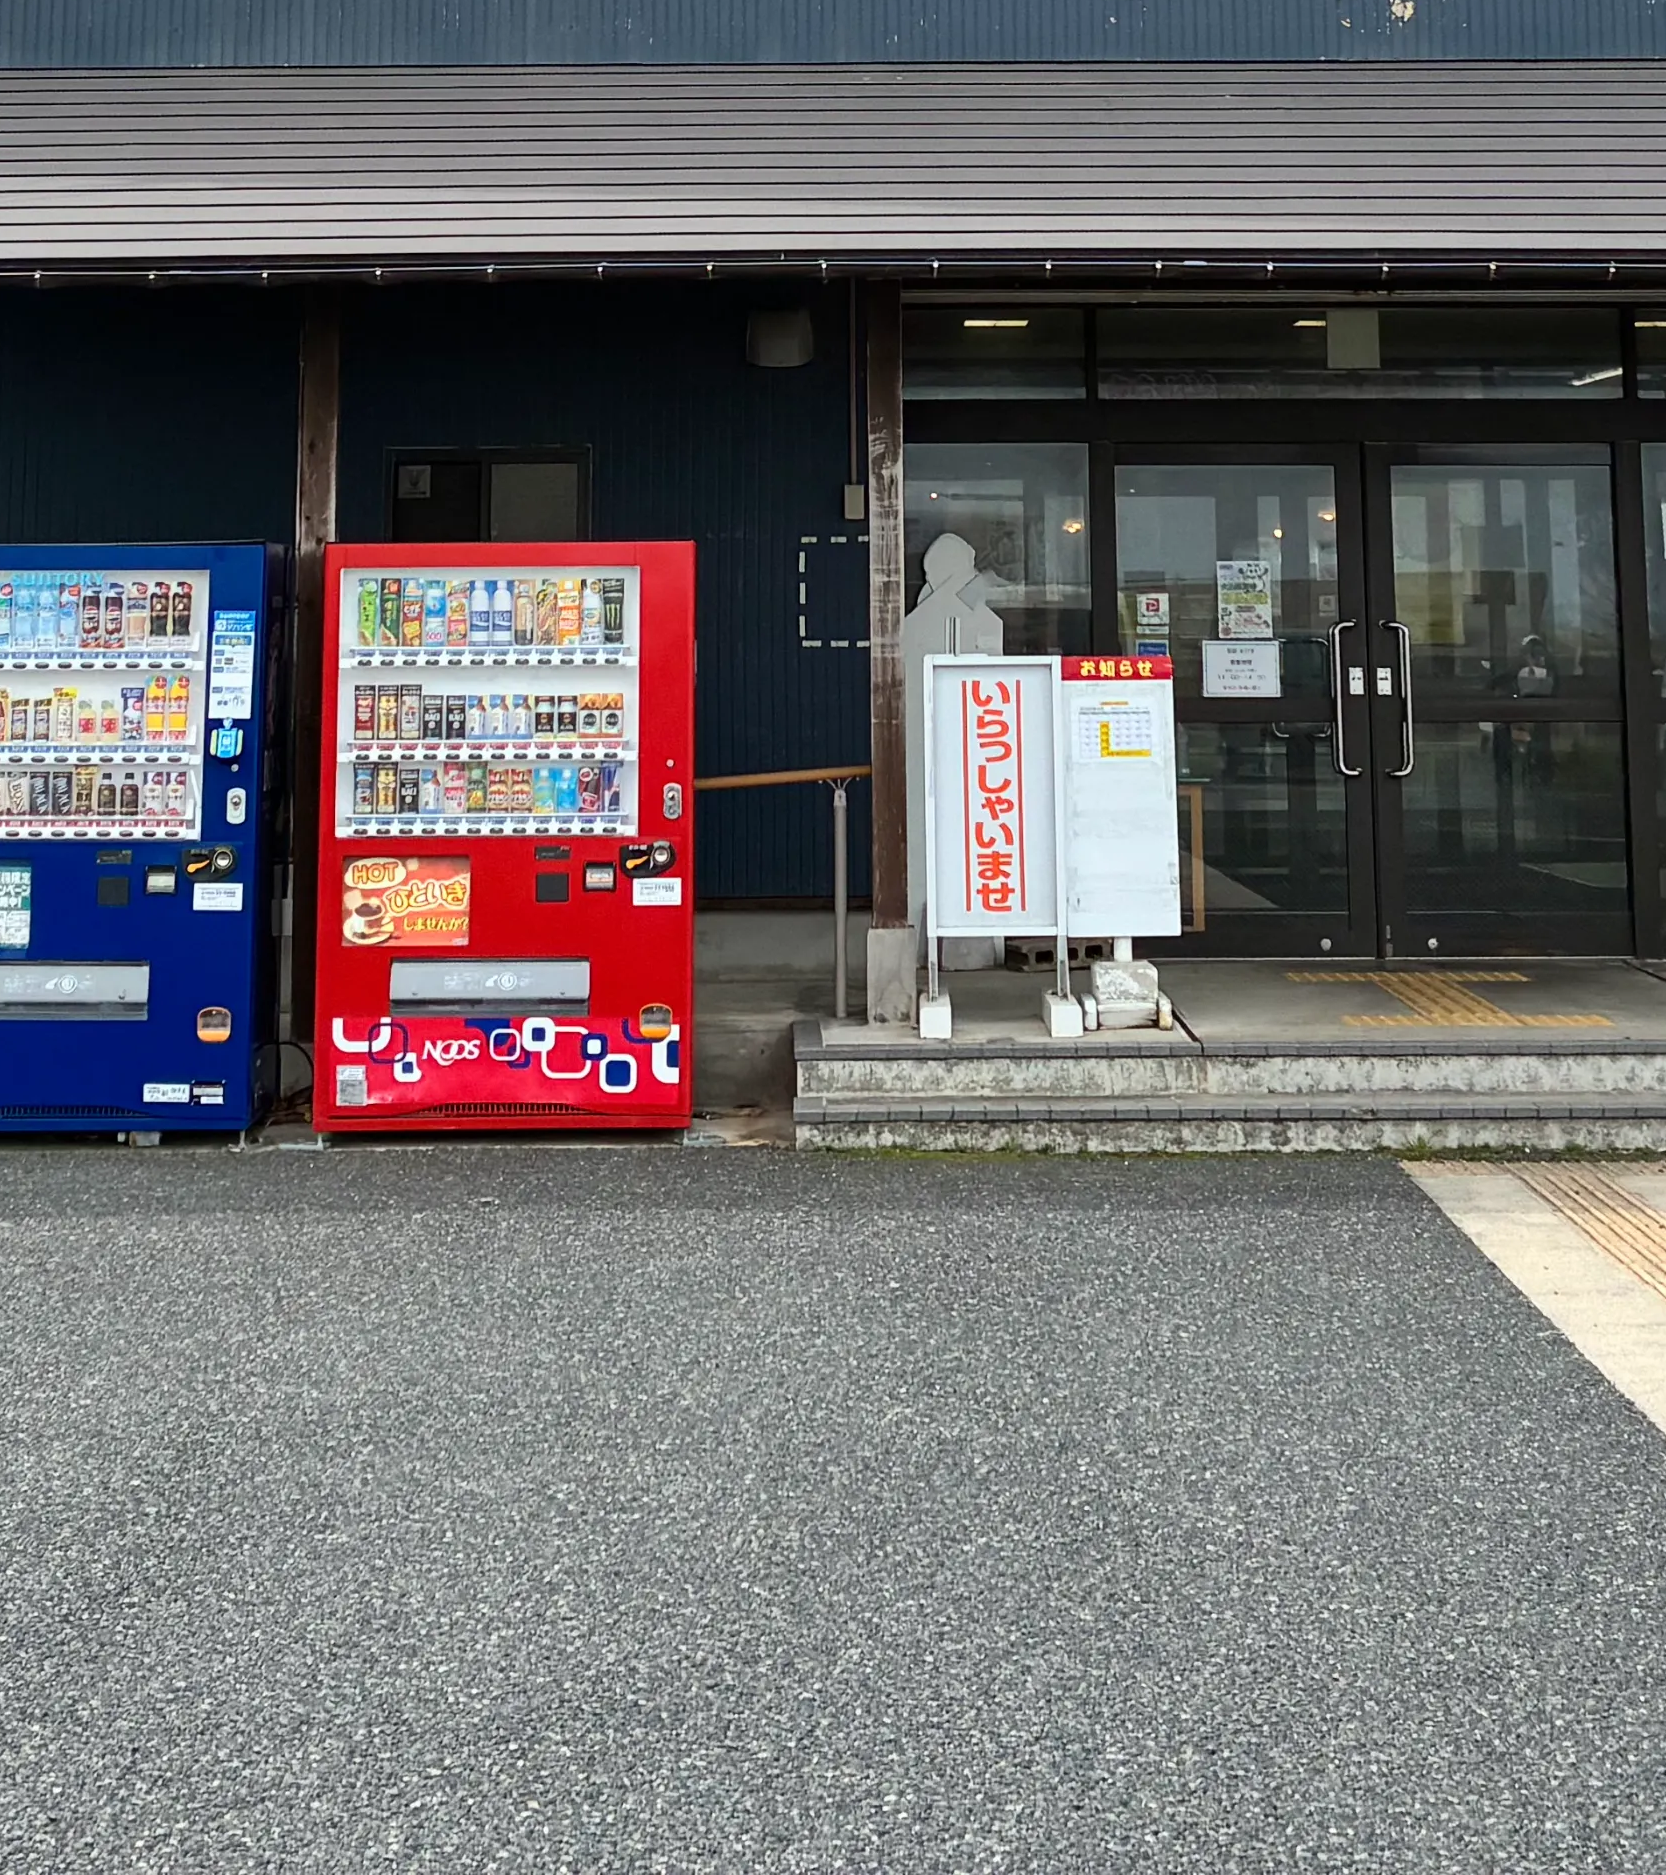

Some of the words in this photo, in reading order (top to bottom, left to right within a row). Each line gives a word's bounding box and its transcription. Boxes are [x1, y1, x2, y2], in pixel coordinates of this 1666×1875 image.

[1080, 659, 1155, 677] お知らせ
[971, 680, 1016, 912] いらっしゃいませ
[352, 862, 399, 885] HOT
[385, 879, 468, 914] ひといき
